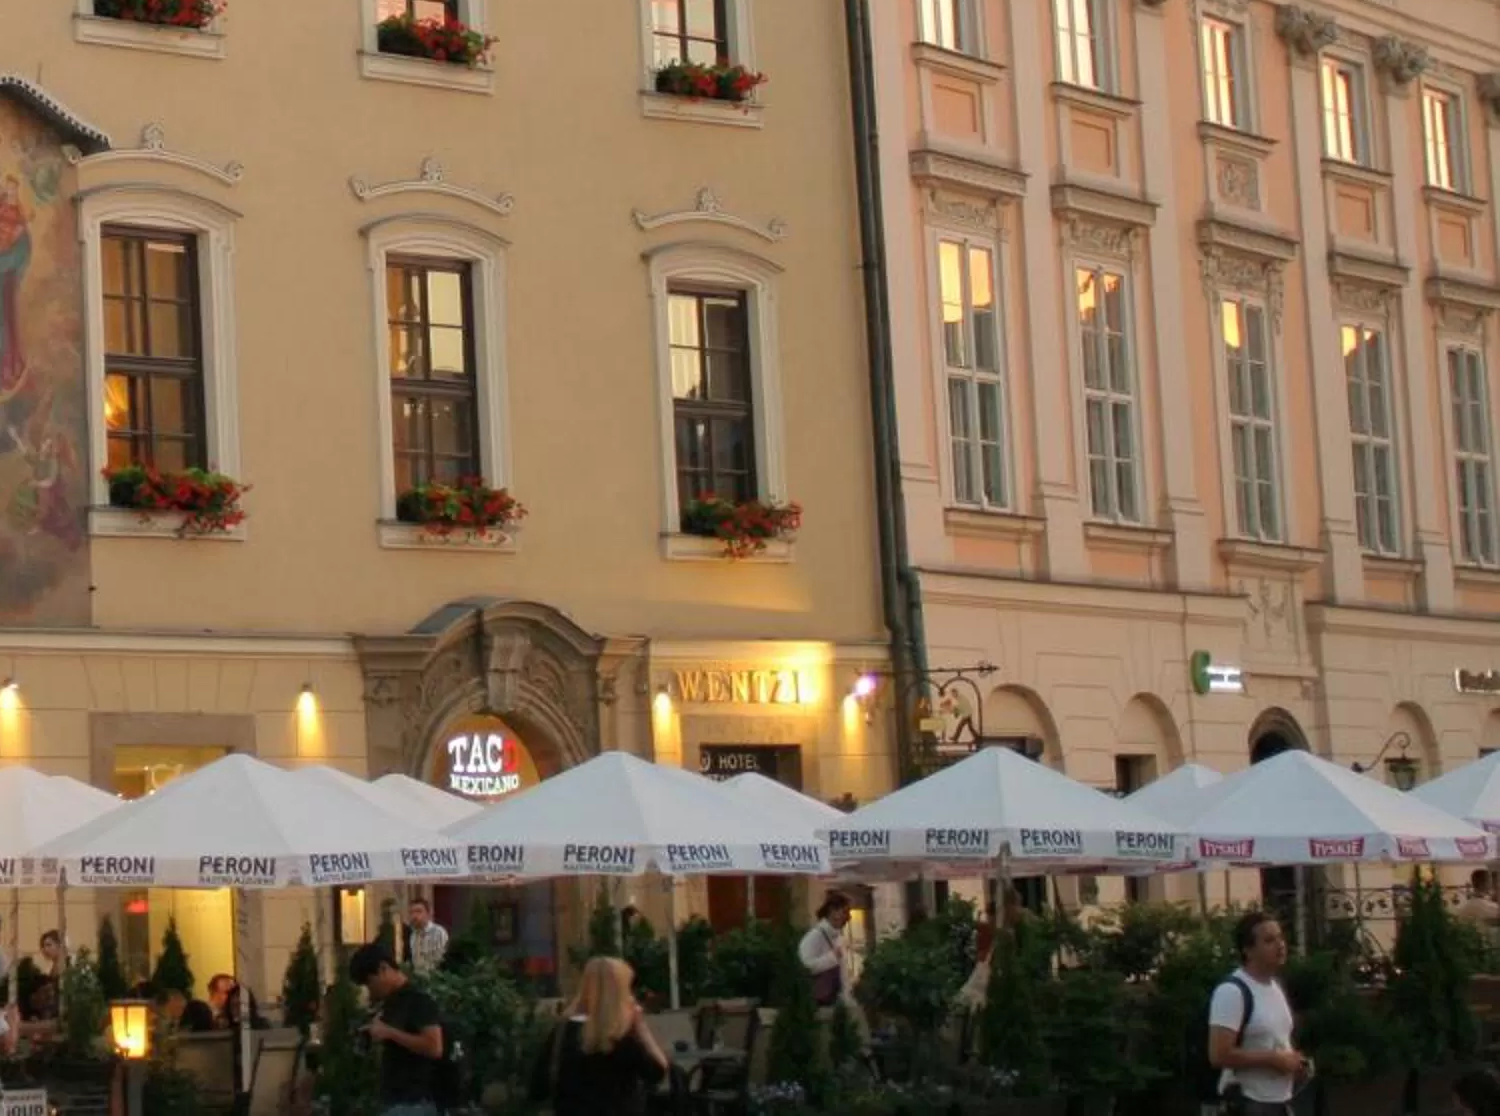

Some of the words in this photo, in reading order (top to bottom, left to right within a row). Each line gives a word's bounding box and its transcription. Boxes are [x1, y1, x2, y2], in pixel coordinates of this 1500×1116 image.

[447, 733, 517, 773] TACO
[450, 773, 519, 795] MEXICANO
[829, 829, 890, 848] PERONI
[925, 827, 989, 846] PERONI
[1020, 827, 1081, 846] PERONI
[1115, 830, 1175, 850] PERONI
[309, 851, 370, 873] PERONI
[400, 847, 457, 868] PERONI
[467, 844, 524, 863] ERONI
[563, 843, 636, 868] PERONI
[667, 843, 730, 863] PERONI
[760, 843, 820, 863] PERONI
[81, 855, 155, 875] PERONI
[199, 855, 276, 876] PERONI
